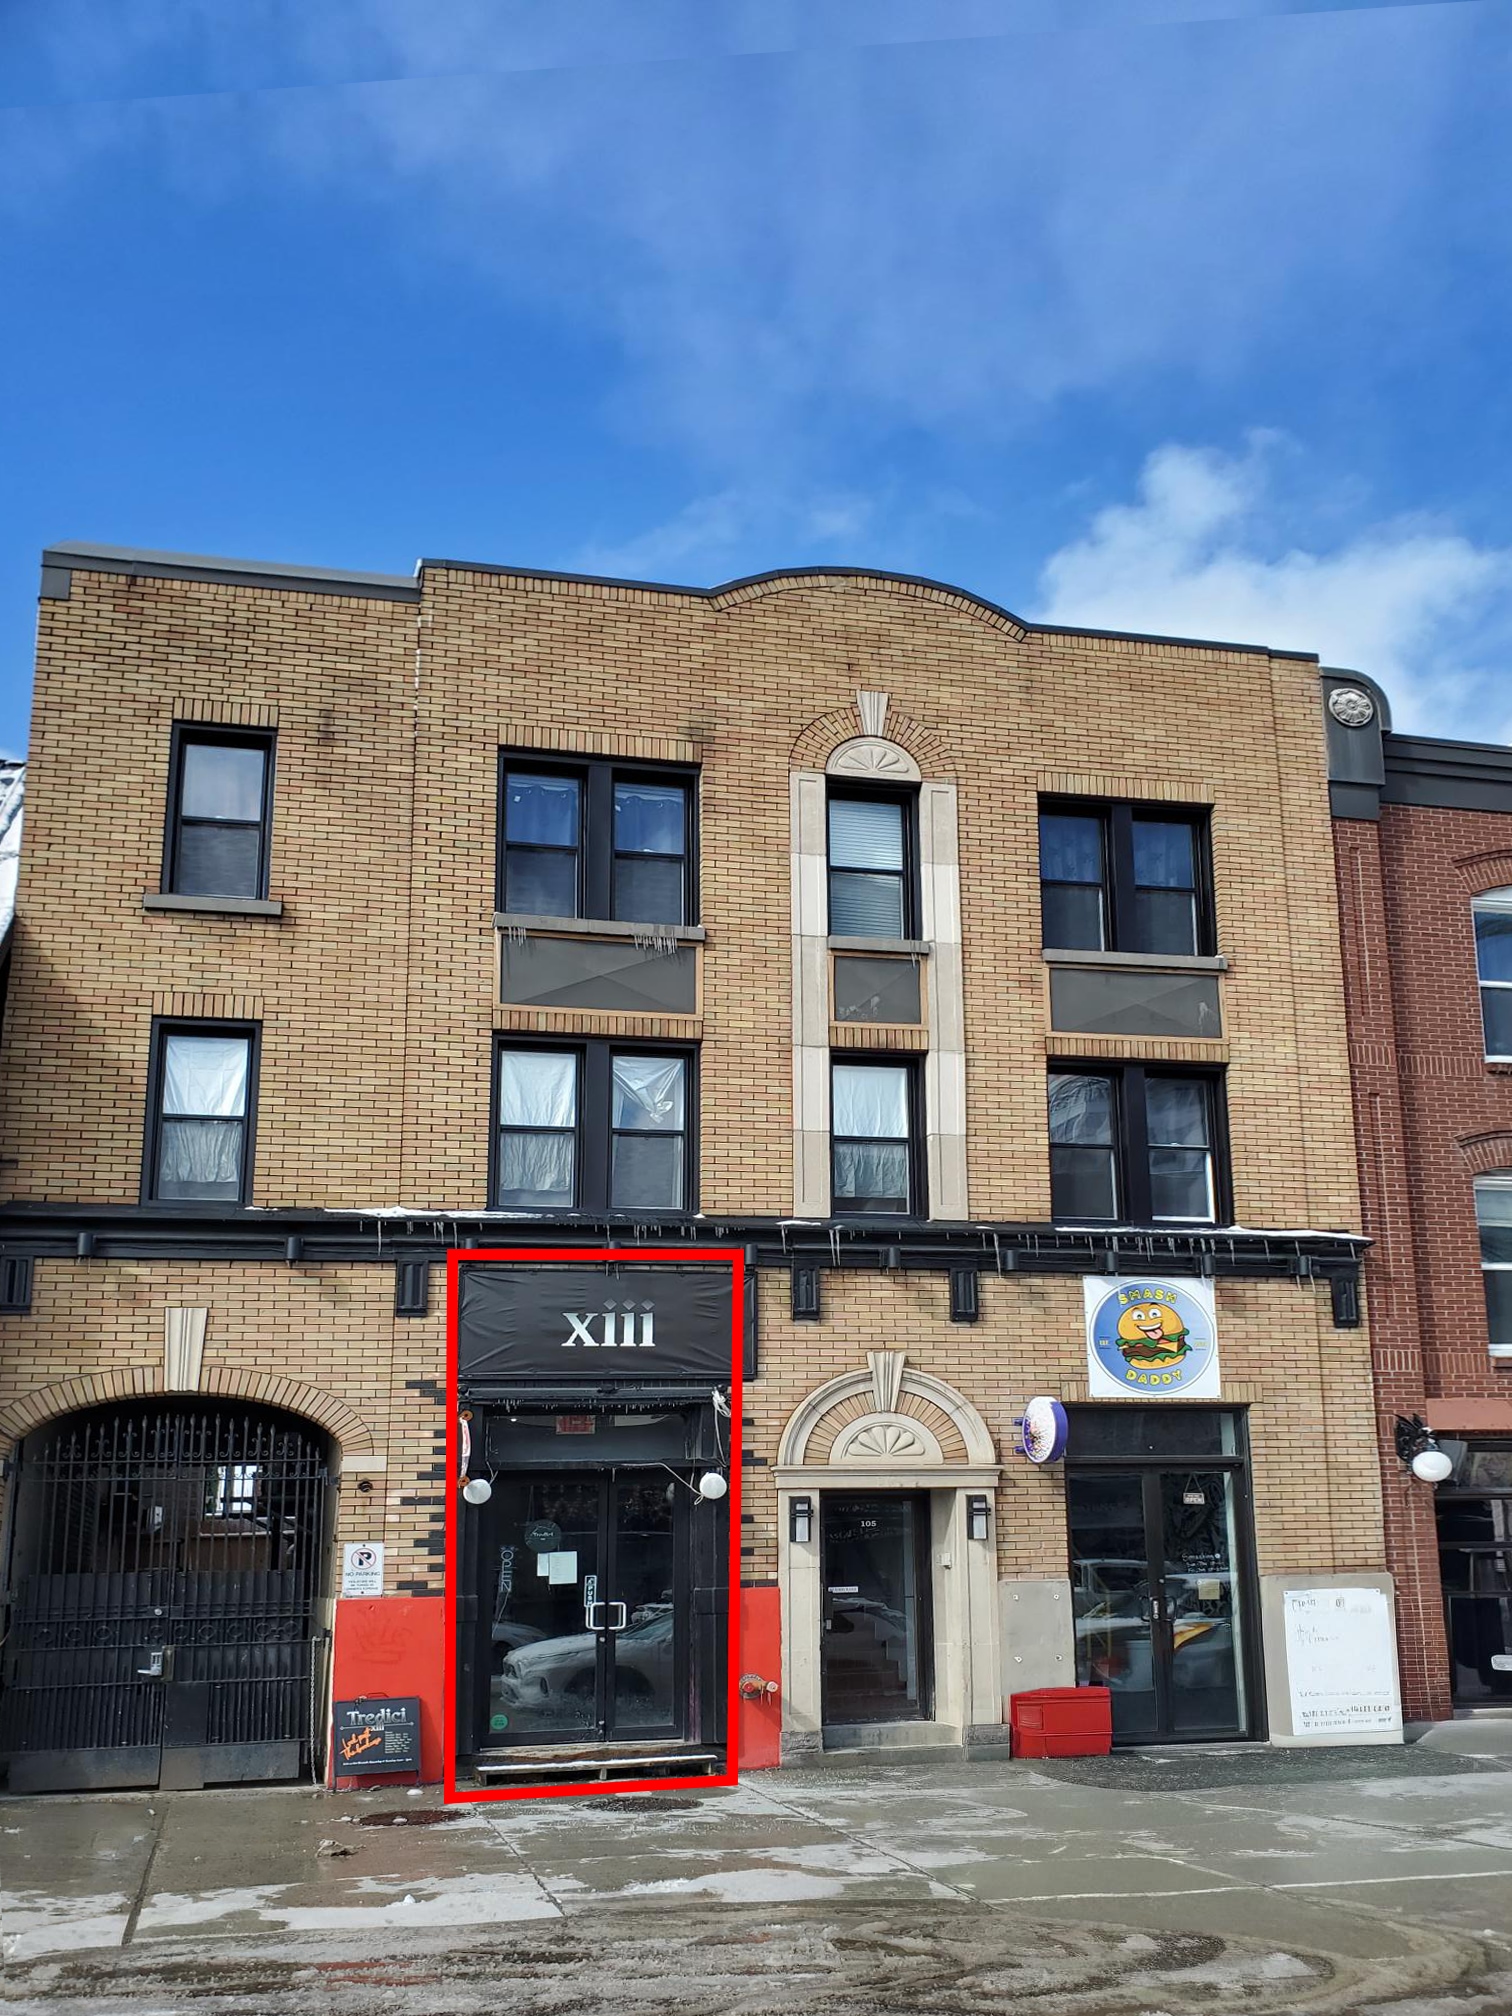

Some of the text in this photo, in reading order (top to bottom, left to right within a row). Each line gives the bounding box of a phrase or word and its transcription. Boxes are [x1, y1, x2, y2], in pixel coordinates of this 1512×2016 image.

[1118, 1288, 1177, 1304] SMASH
[561, 1299, 656, 1347] xiii
[1125, 1369, 1181, 1385] DADDY
[500, 1550, 514, 1592] OPEN
[346, 1707, 407, 1726] Tredici
